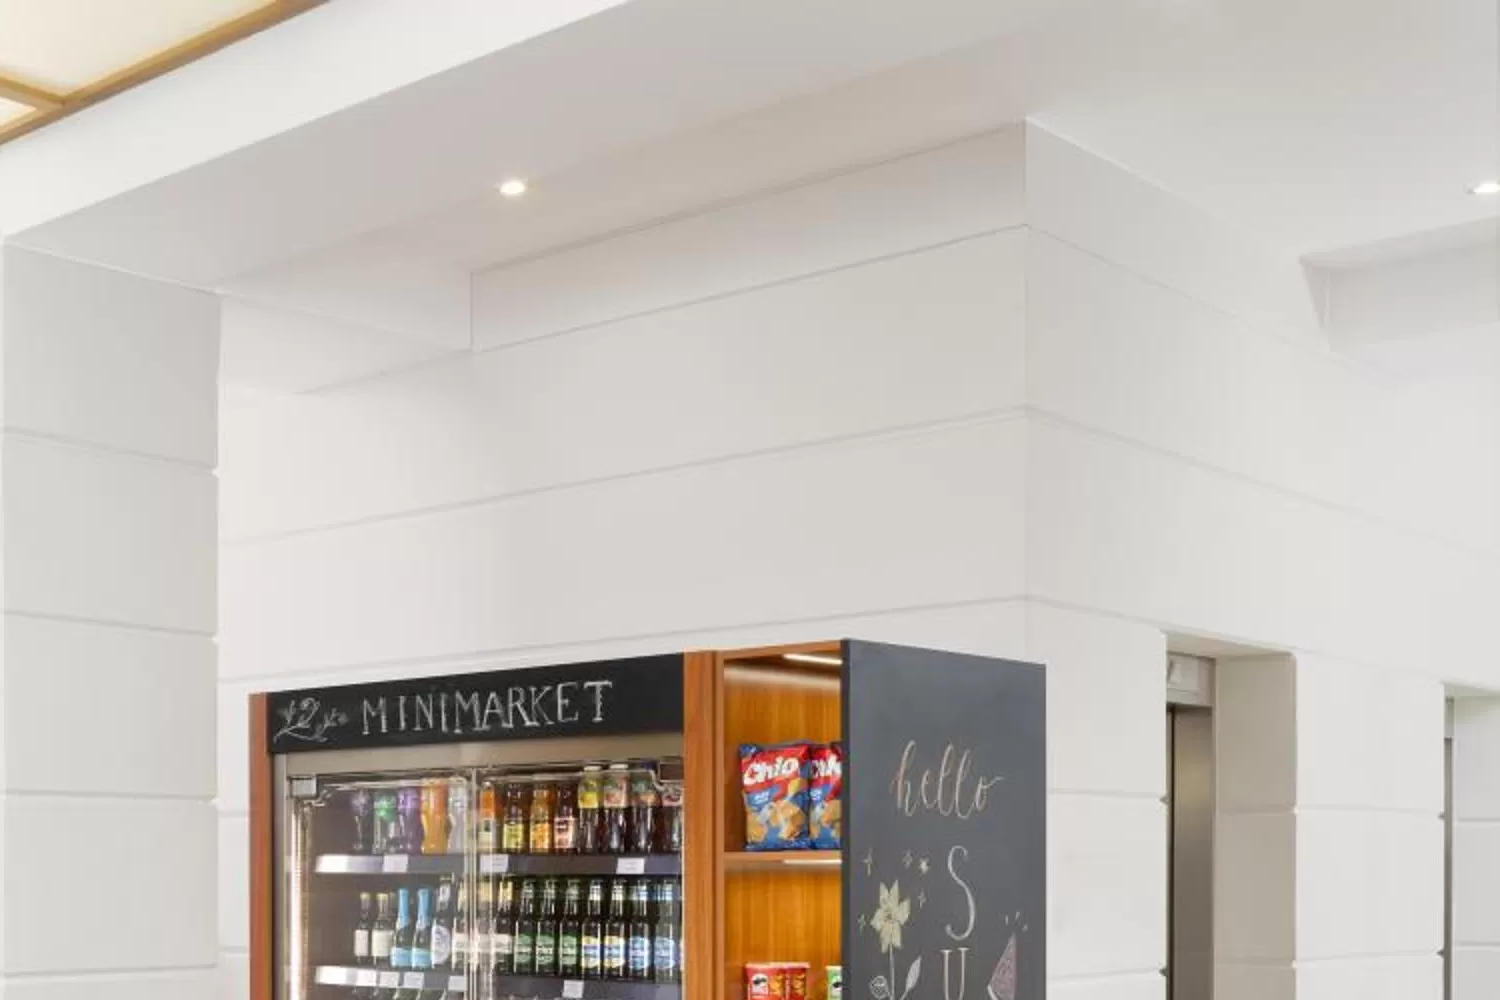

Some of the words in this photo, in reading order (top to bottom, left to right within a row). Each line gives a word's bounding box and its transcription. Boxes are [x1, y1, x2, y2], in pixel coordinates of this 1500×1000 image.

[362, 680, 613, 735] MINIMARKET
[743, 756, 799, 786] Chio
[891, 739, 1004, 820] hello
